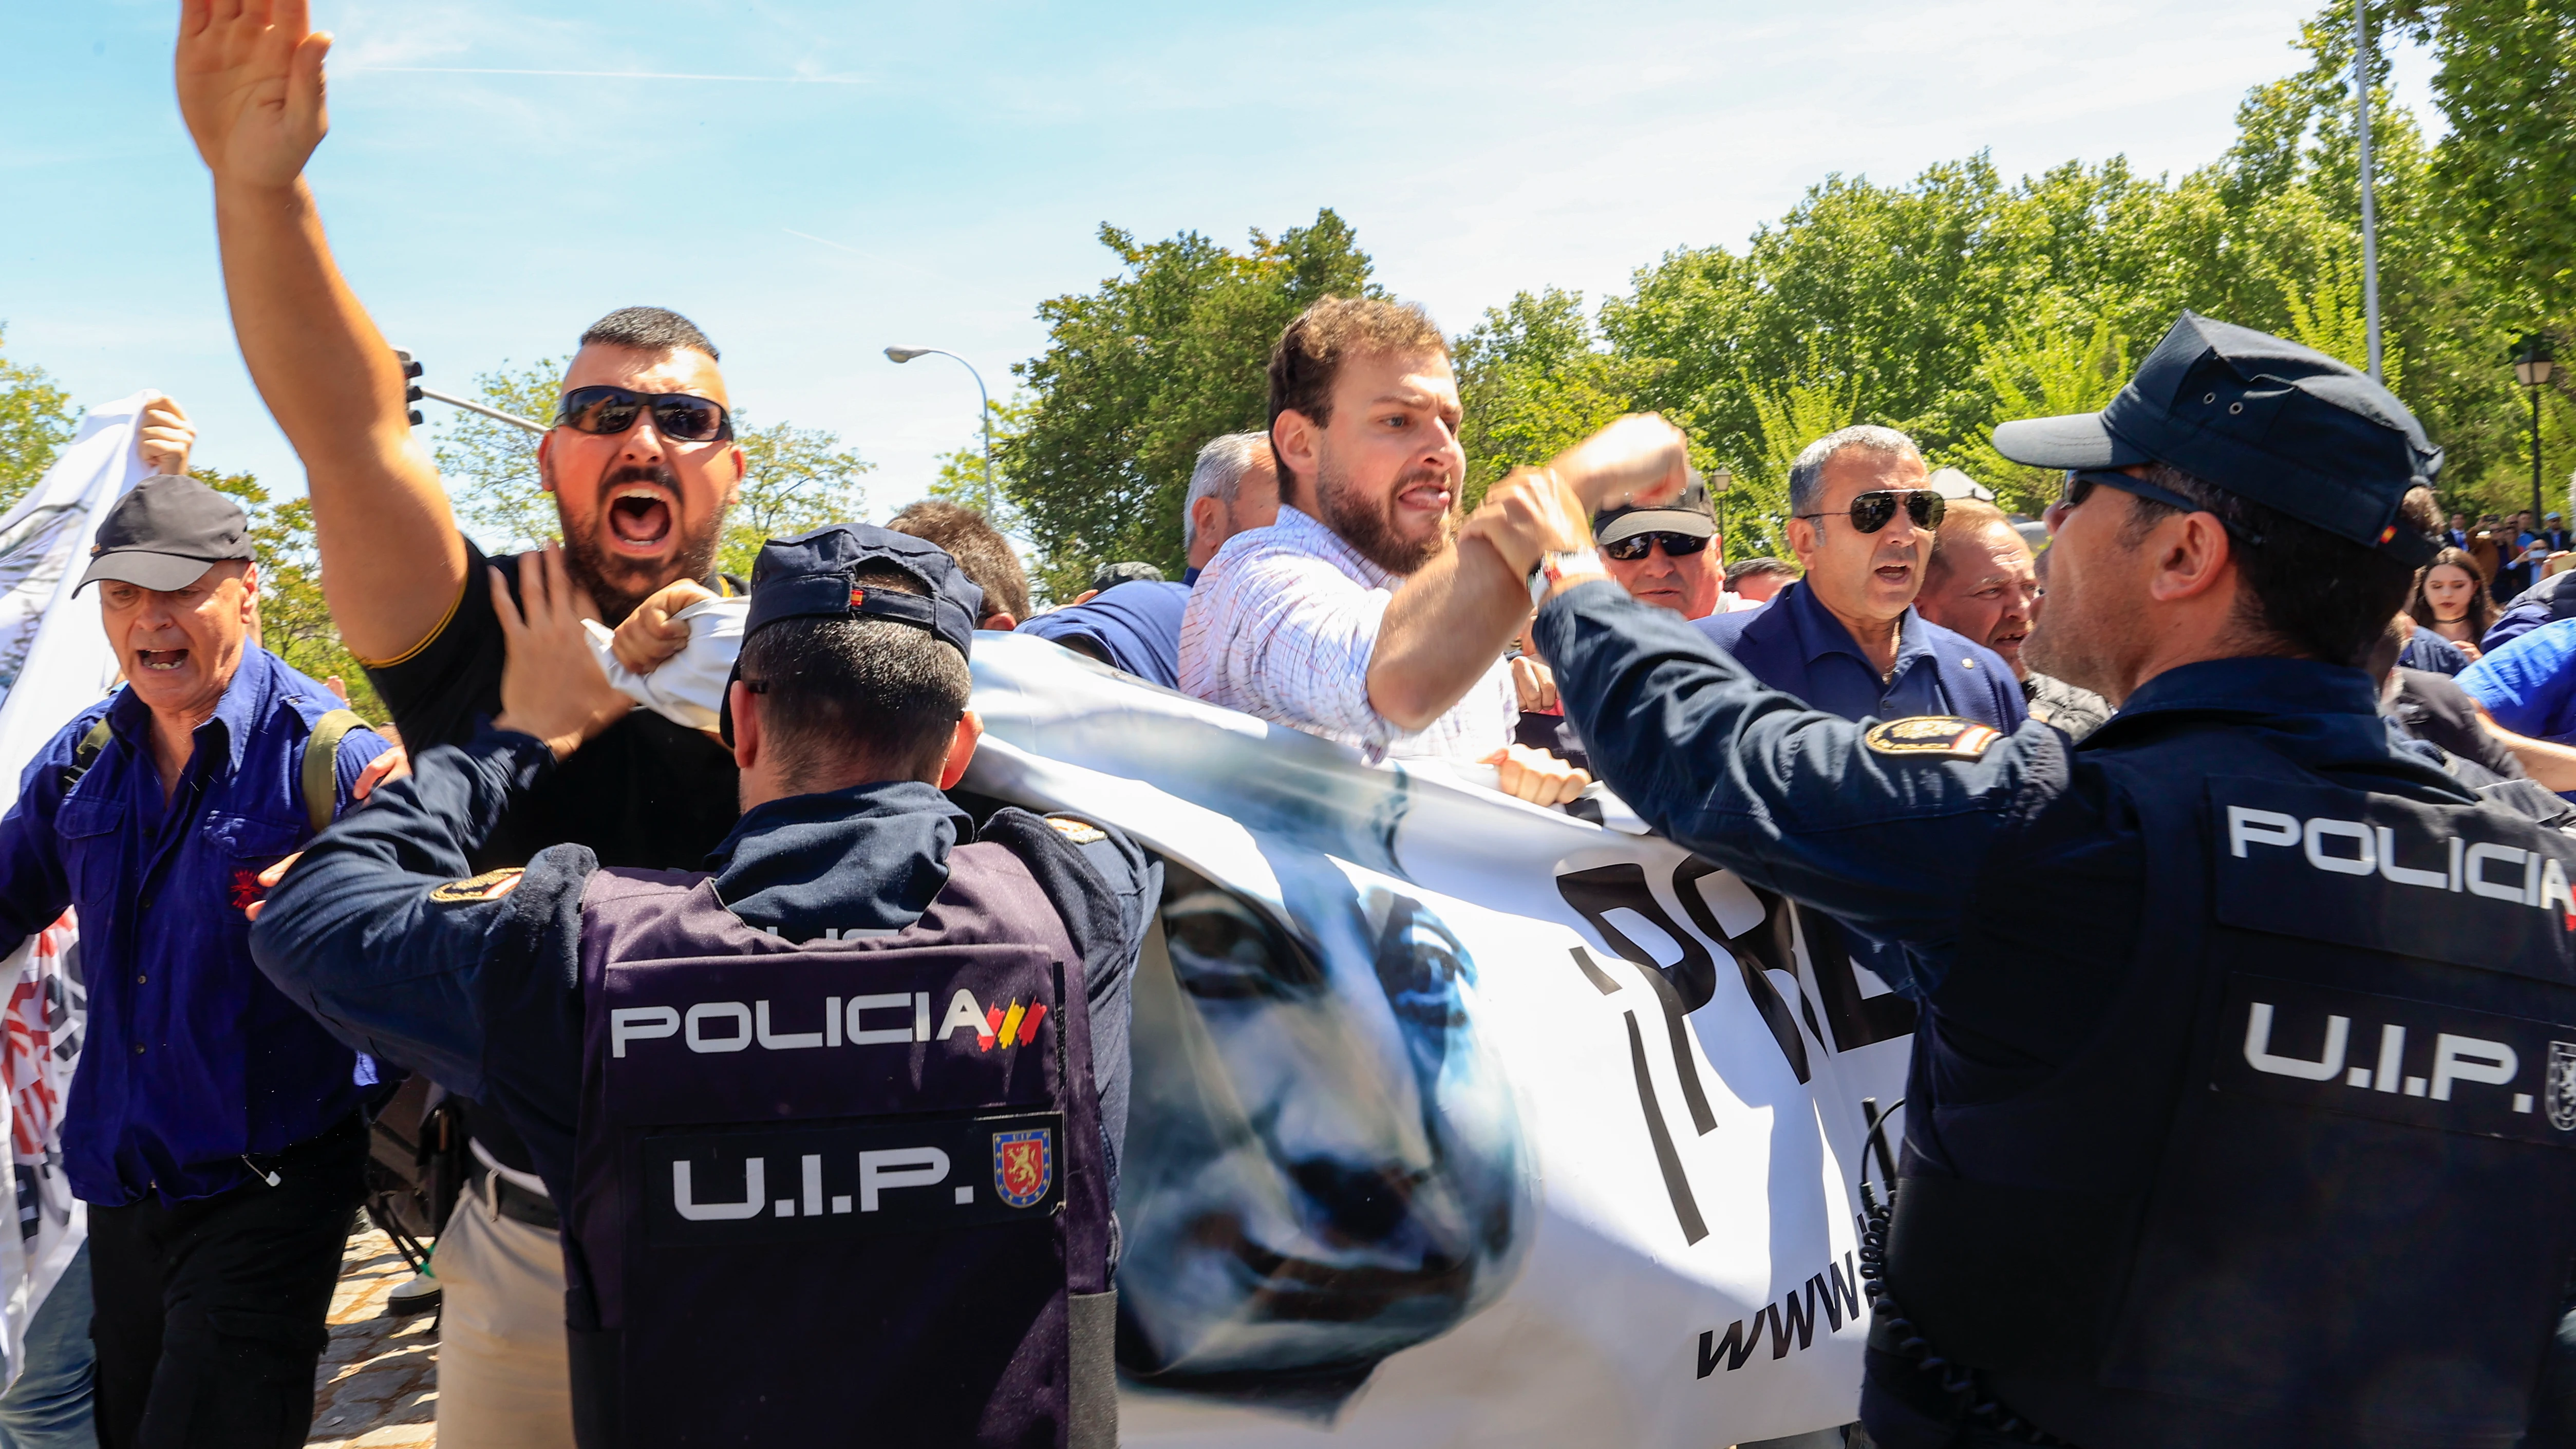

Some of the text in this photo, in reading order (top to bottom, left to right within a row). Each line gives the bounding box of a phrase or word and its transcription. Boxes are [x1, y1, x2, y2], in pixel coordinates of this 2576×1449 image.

[2227, 805, 2576, 916] POLICIA
[611, 988, 993, 1058] POLICIA
[2243, 1003, 2534, 1114] U.I.P.
[673, 1146, 974, 1221] U.I.P.
